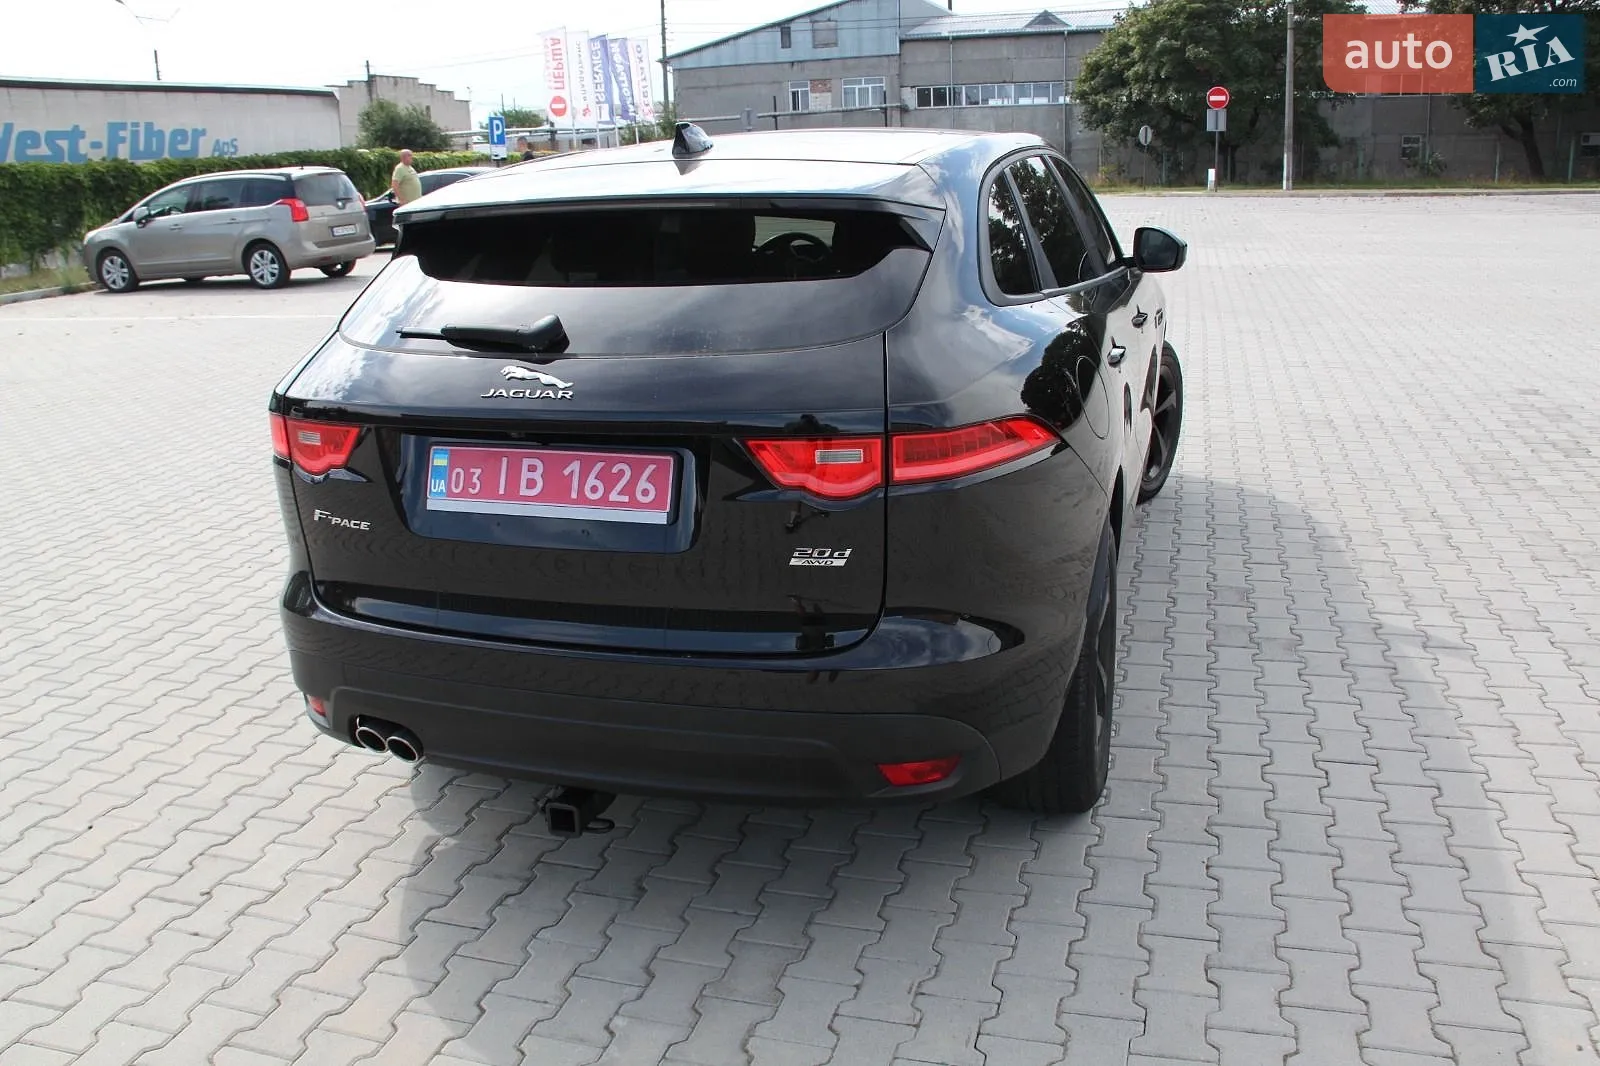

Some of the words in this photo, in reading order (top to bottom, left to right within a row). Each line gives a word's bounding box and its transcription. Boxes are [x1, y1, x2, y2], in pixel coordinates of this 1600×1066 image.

[493, 119, 503, 144] P
[480, 388, 574, 400] JAGUAR
[431, 480, 446, 493] UA
[451, 467, 483, 494] 03
[498, 456, 544, 497] IB
[562, 459, 656, 504] 1626
[313, 509, 371, 531] F-PACE
[792, 547, 853, 558] 20d
